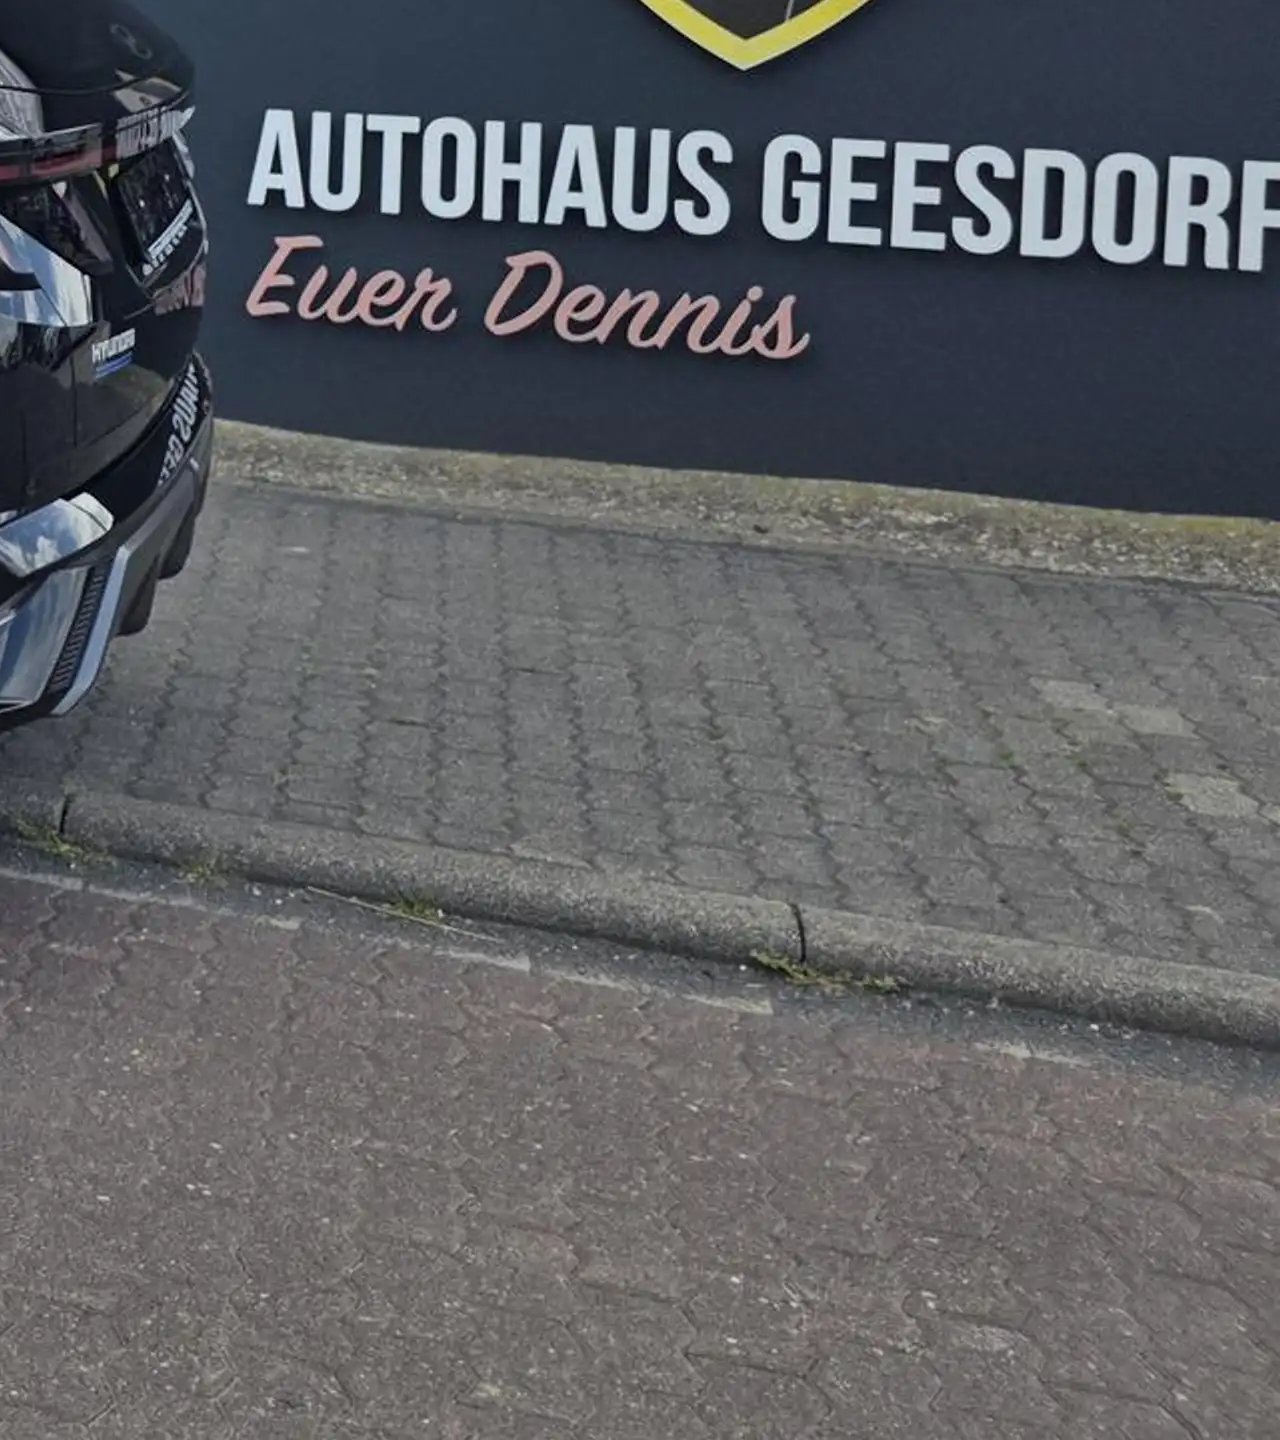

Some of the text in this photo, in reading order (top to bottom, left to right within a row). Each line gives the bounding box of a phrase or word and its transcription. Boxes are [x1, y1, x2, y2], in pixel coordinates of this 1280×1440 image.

[247, 108, 733, 236] AUTOHAUS
[246, 235, 457, 331] Euer
[484, 250, 810, 359] Dennis
